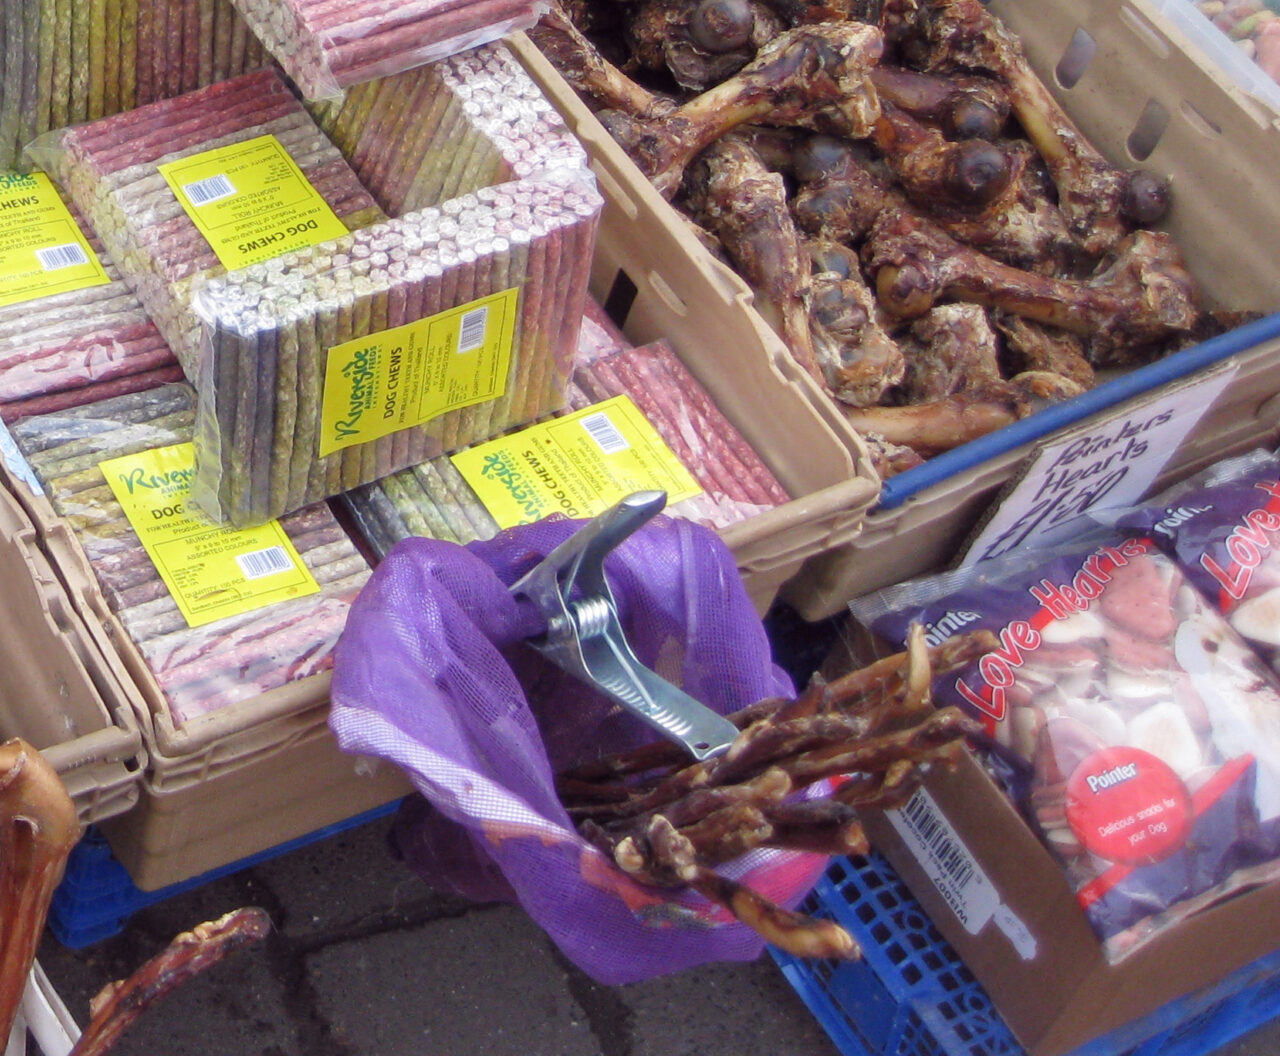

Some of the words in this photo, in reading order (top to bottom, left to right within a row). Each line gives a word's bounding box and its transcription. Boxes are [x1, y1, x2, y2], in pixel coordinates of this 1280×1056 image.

[238, 231, 286, 254] CHEWS
[286, 219, 318, 237] DOG
[387, 347, 403, 390] CHEWS
[334, 348, 374, 441] Riverside
[383, 391, 397, 419] DOG
[119, 467, 196, 495] River
[522, 450, 557, 489] CHEWS
[1033, 438, 1148, 501] Hearts
[161, 482, 194, 494] ANIMA
[151, 504, 185, 520] DOG
[553, 490, 579, 517] DOG
[1200, 509, 1280, 600] Love
[905, 610, 982, 648] ointer
[956, 621, 1041, 720] Love
[1030, 539, 1148, 621] Hearts
[1086, 762, 1137, 794] Pointer
[1147, 822, 1168, 835] Dog
